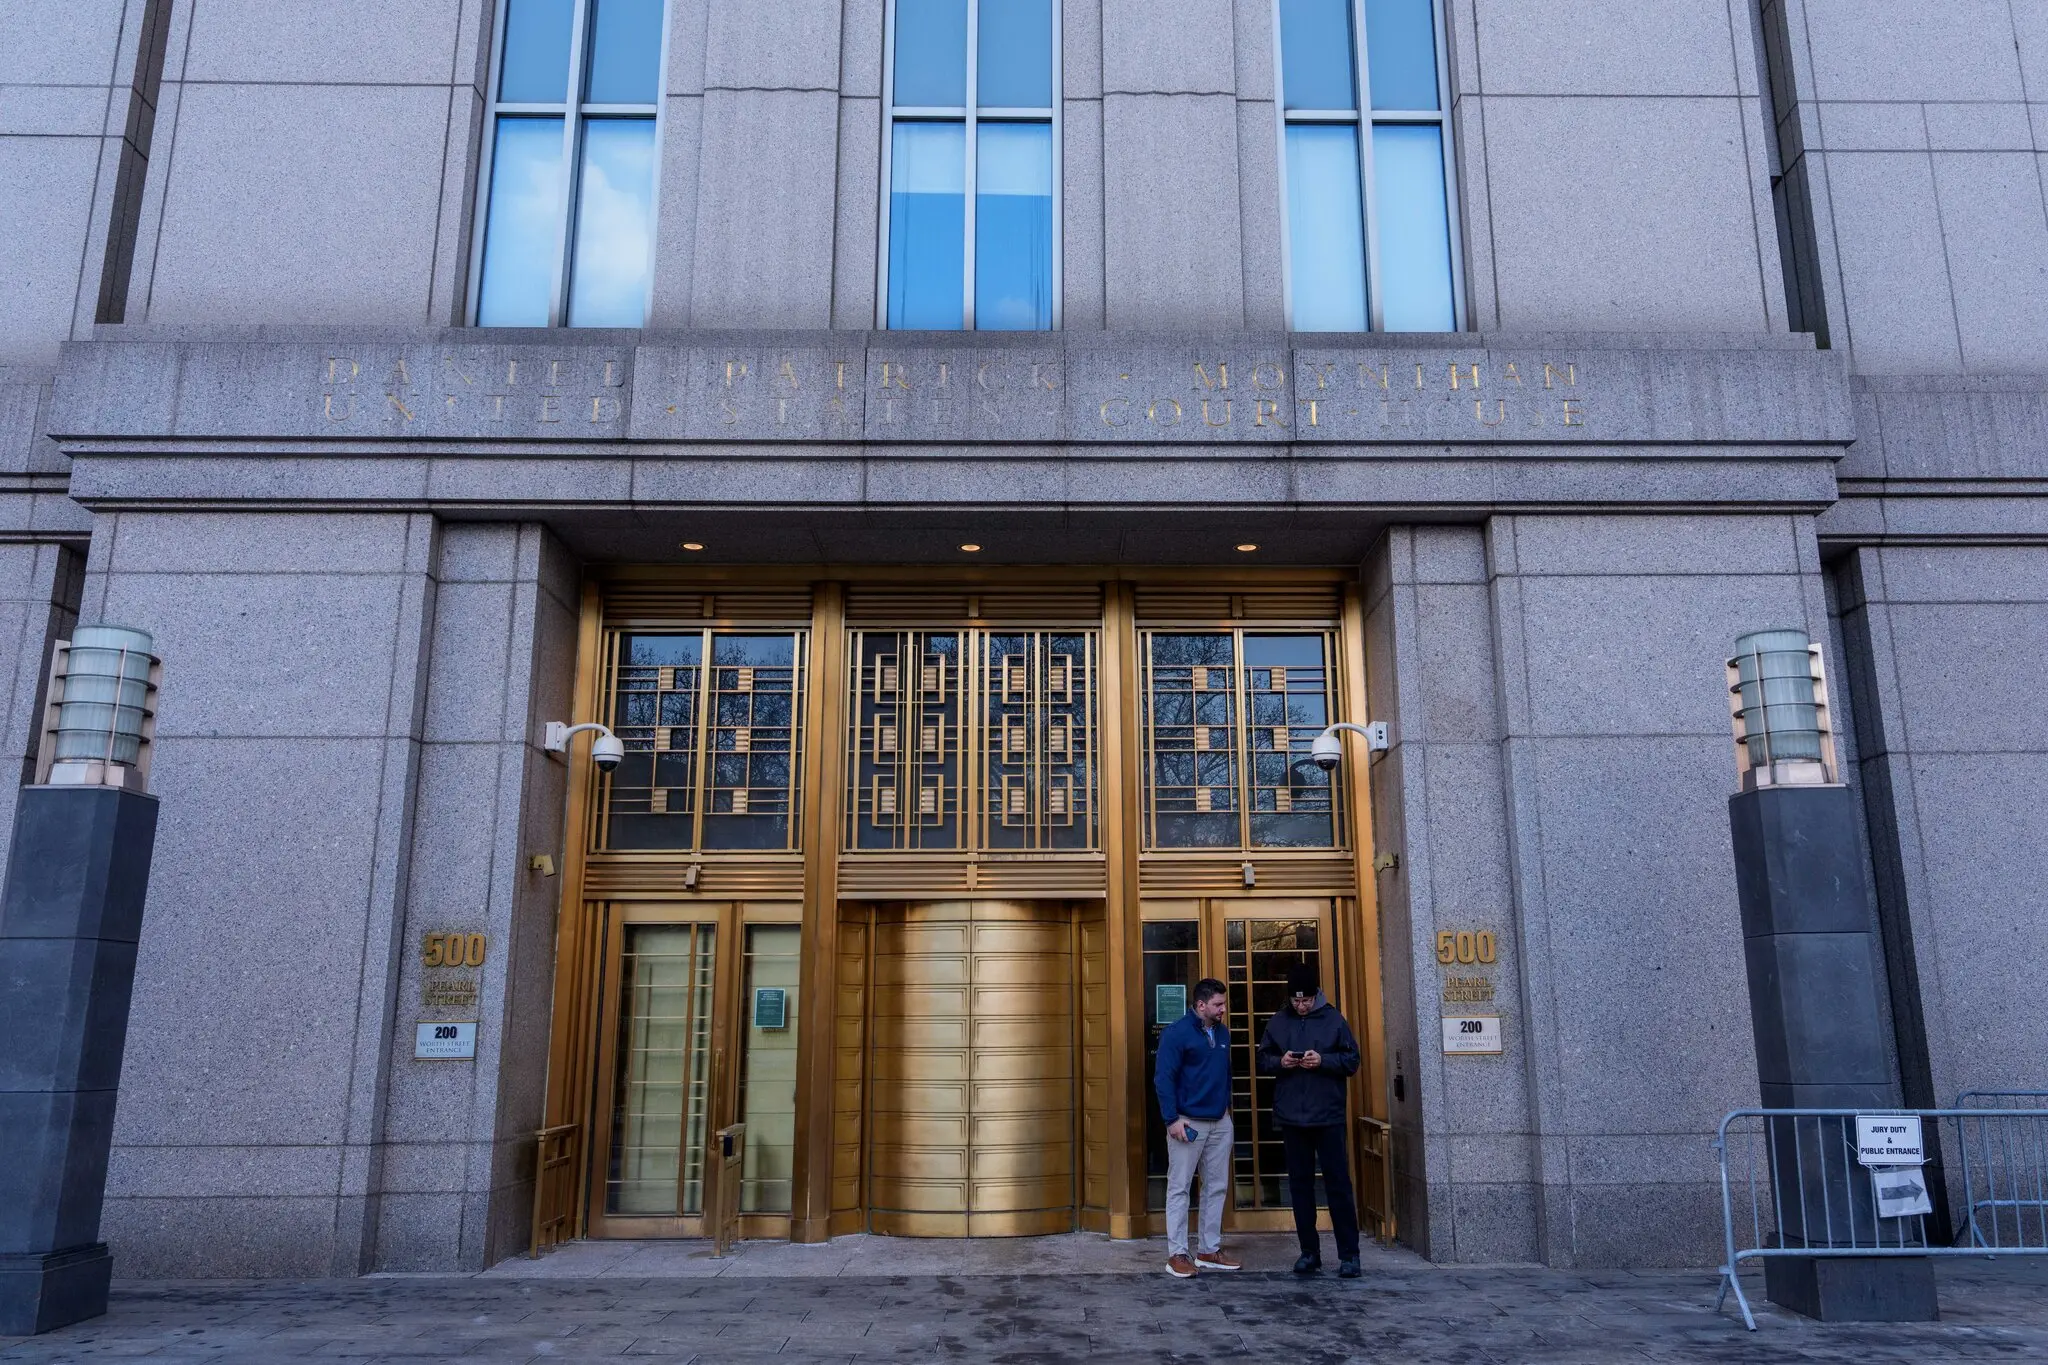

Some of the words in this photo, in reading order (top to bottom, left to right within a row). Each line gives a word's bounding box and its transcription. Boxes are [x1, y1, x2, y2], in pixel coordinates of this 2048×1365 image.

[324, 357, 627, 388] DANIEL
[723, 360, 1059, 391] PATRICK
[1192, 361, 1579, 391] MOYNIHAN
[323, 393, 623, 424] UNITED
[720, 396, 1004, 426] STATES
[1100, 398, 1327, 428] COURT
[424, 932, 486, 967] 500
[1436, 931, 1495, 964] 500
[429, 980, 476, 993] PEARL
[1446, 977, 1491, 988] PEARL
[425, 993, 478, 1006] STREET
[1443, 989, 1495, 1002] STREET
[435, 1026, 457, 1039] 200
[1460, 1020, 1482, 1033] 200
[1871, 1126, 1889, 1134] JURY
[1890, 1126, 1907, 1134] DUTY
